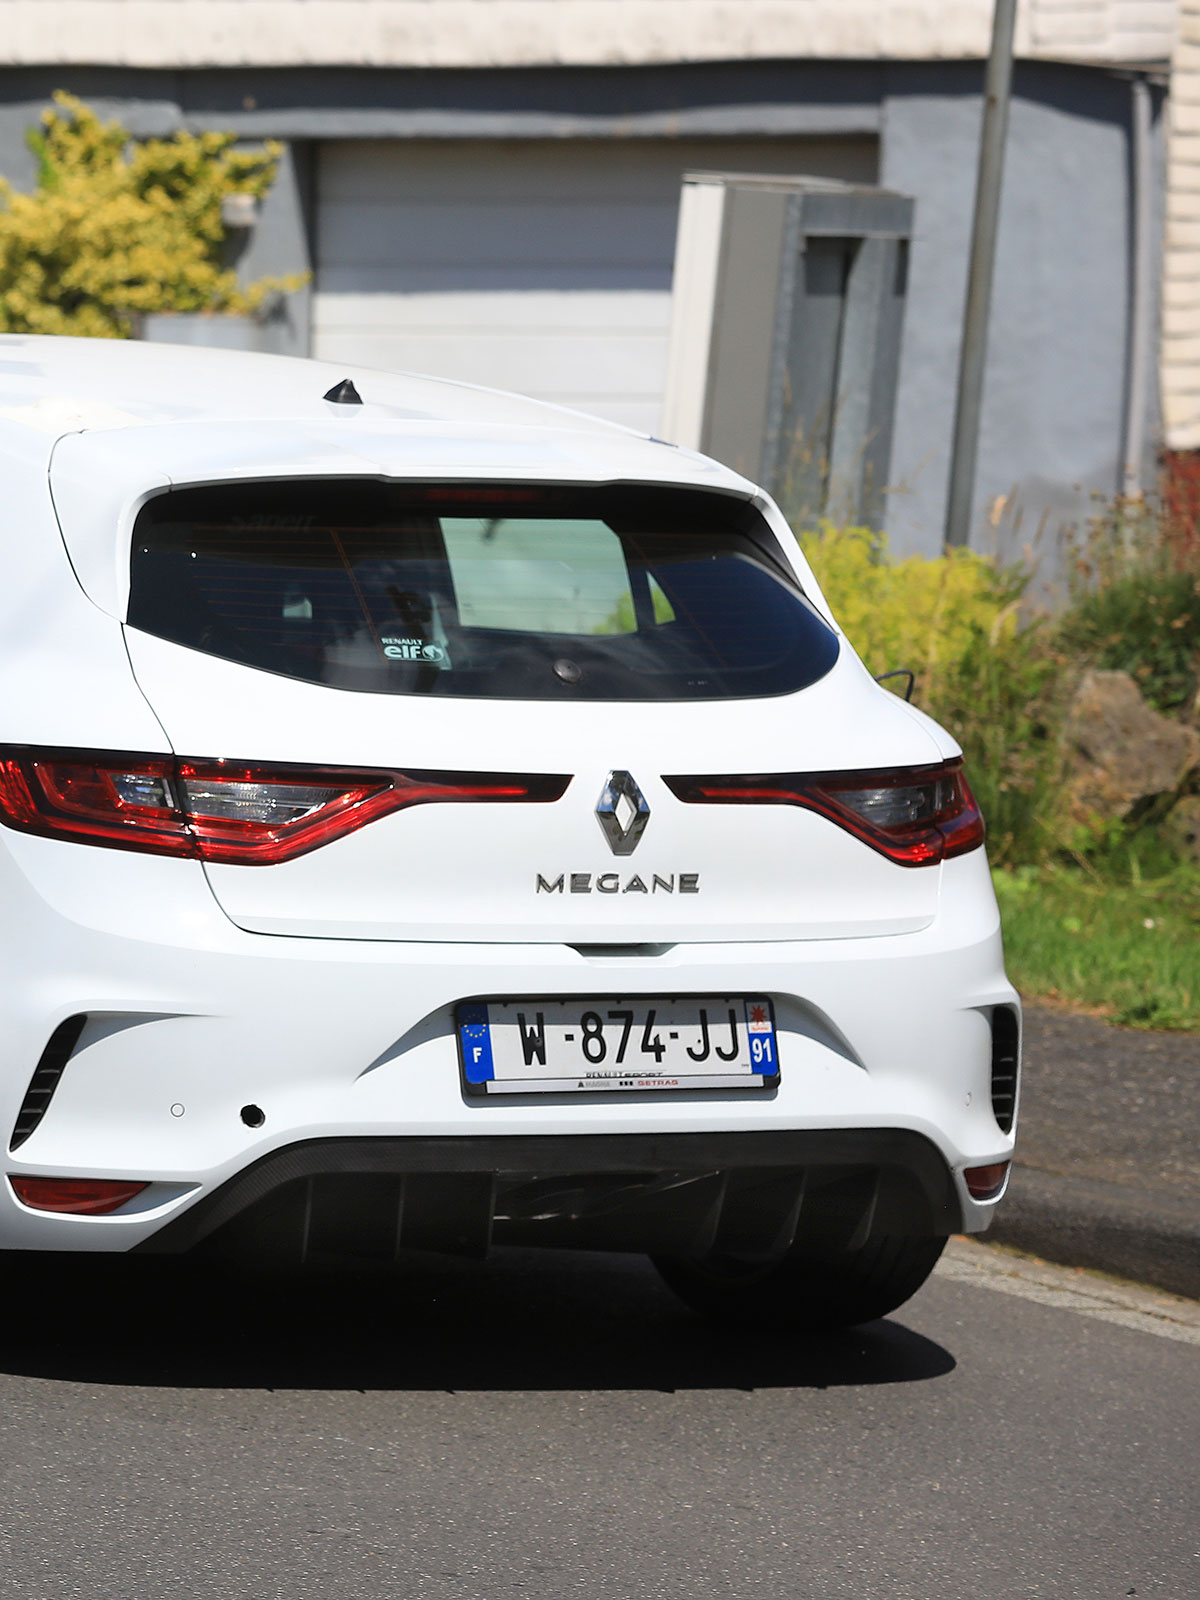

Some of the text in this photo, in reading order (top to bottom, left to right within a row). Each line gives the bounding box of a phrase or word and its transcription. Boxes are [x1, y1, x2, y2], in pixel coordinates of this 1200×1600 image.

[381, 637, 423, 645] RENAULT
[384, 645, 421, 658] elf
[536, 873, 700, 894] MEGANE
[472, 1047, 483, 1063] F
[752, 1038, 773, 1063] 91
